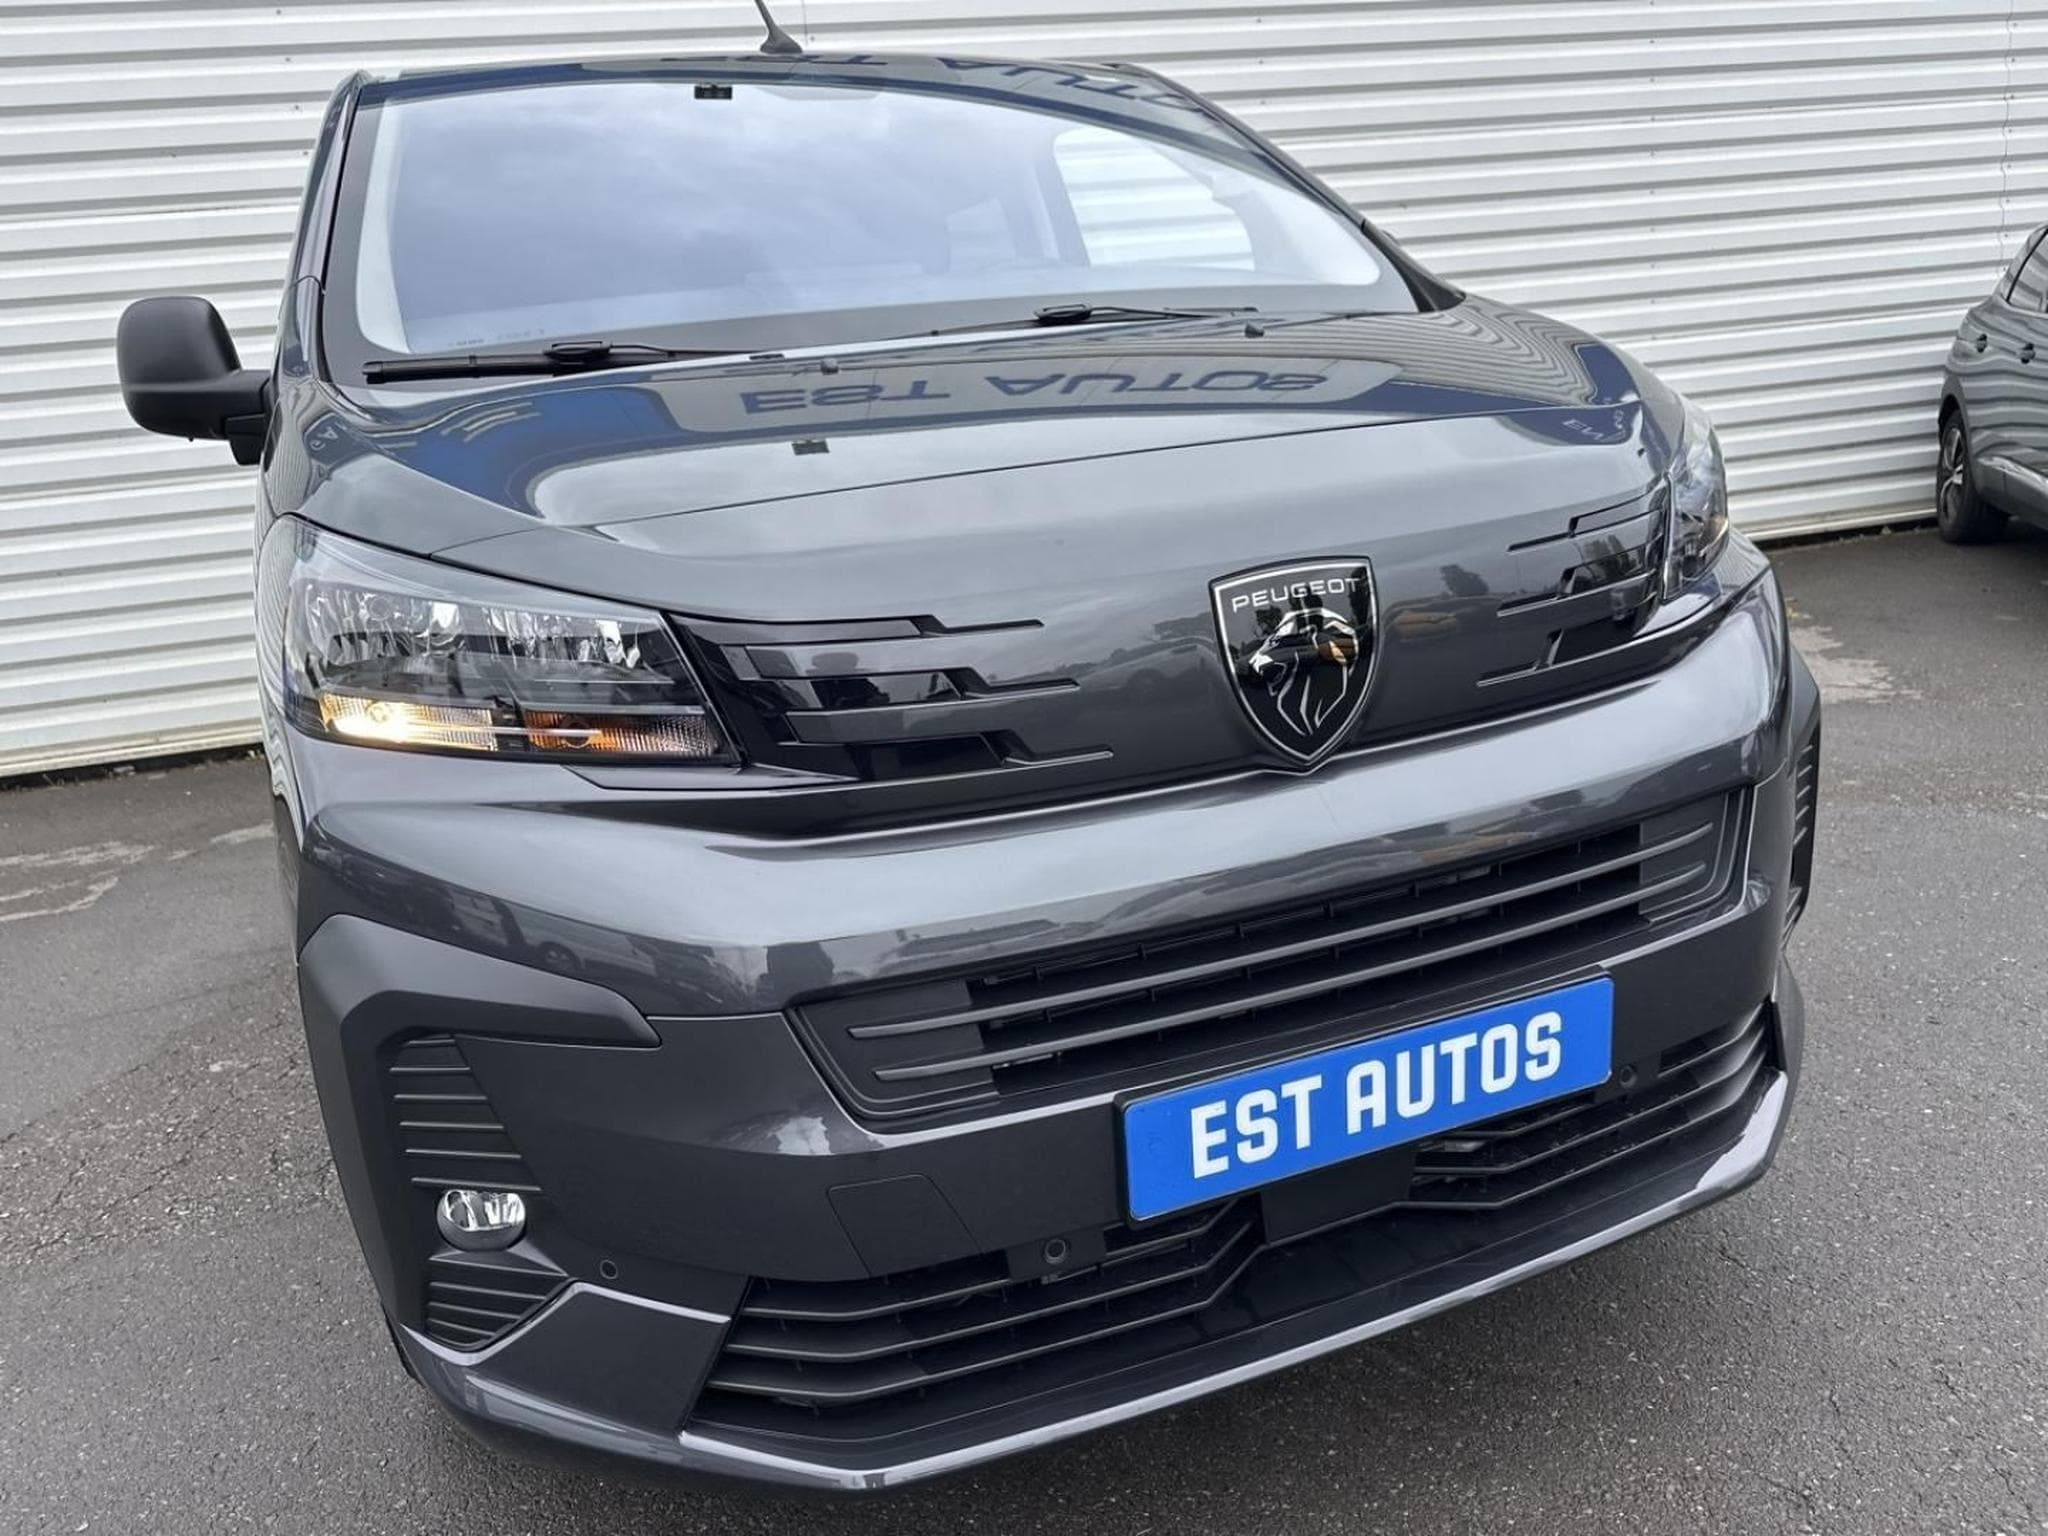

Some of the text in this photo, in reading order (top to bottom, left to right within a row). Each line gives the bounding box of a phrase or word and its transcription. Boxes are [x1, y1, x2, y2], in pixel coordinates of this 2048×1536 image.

[1231, 577, 1361, 613] PEUGEOT
[1190, 1010, 1563, 1180] EST AUTOS
